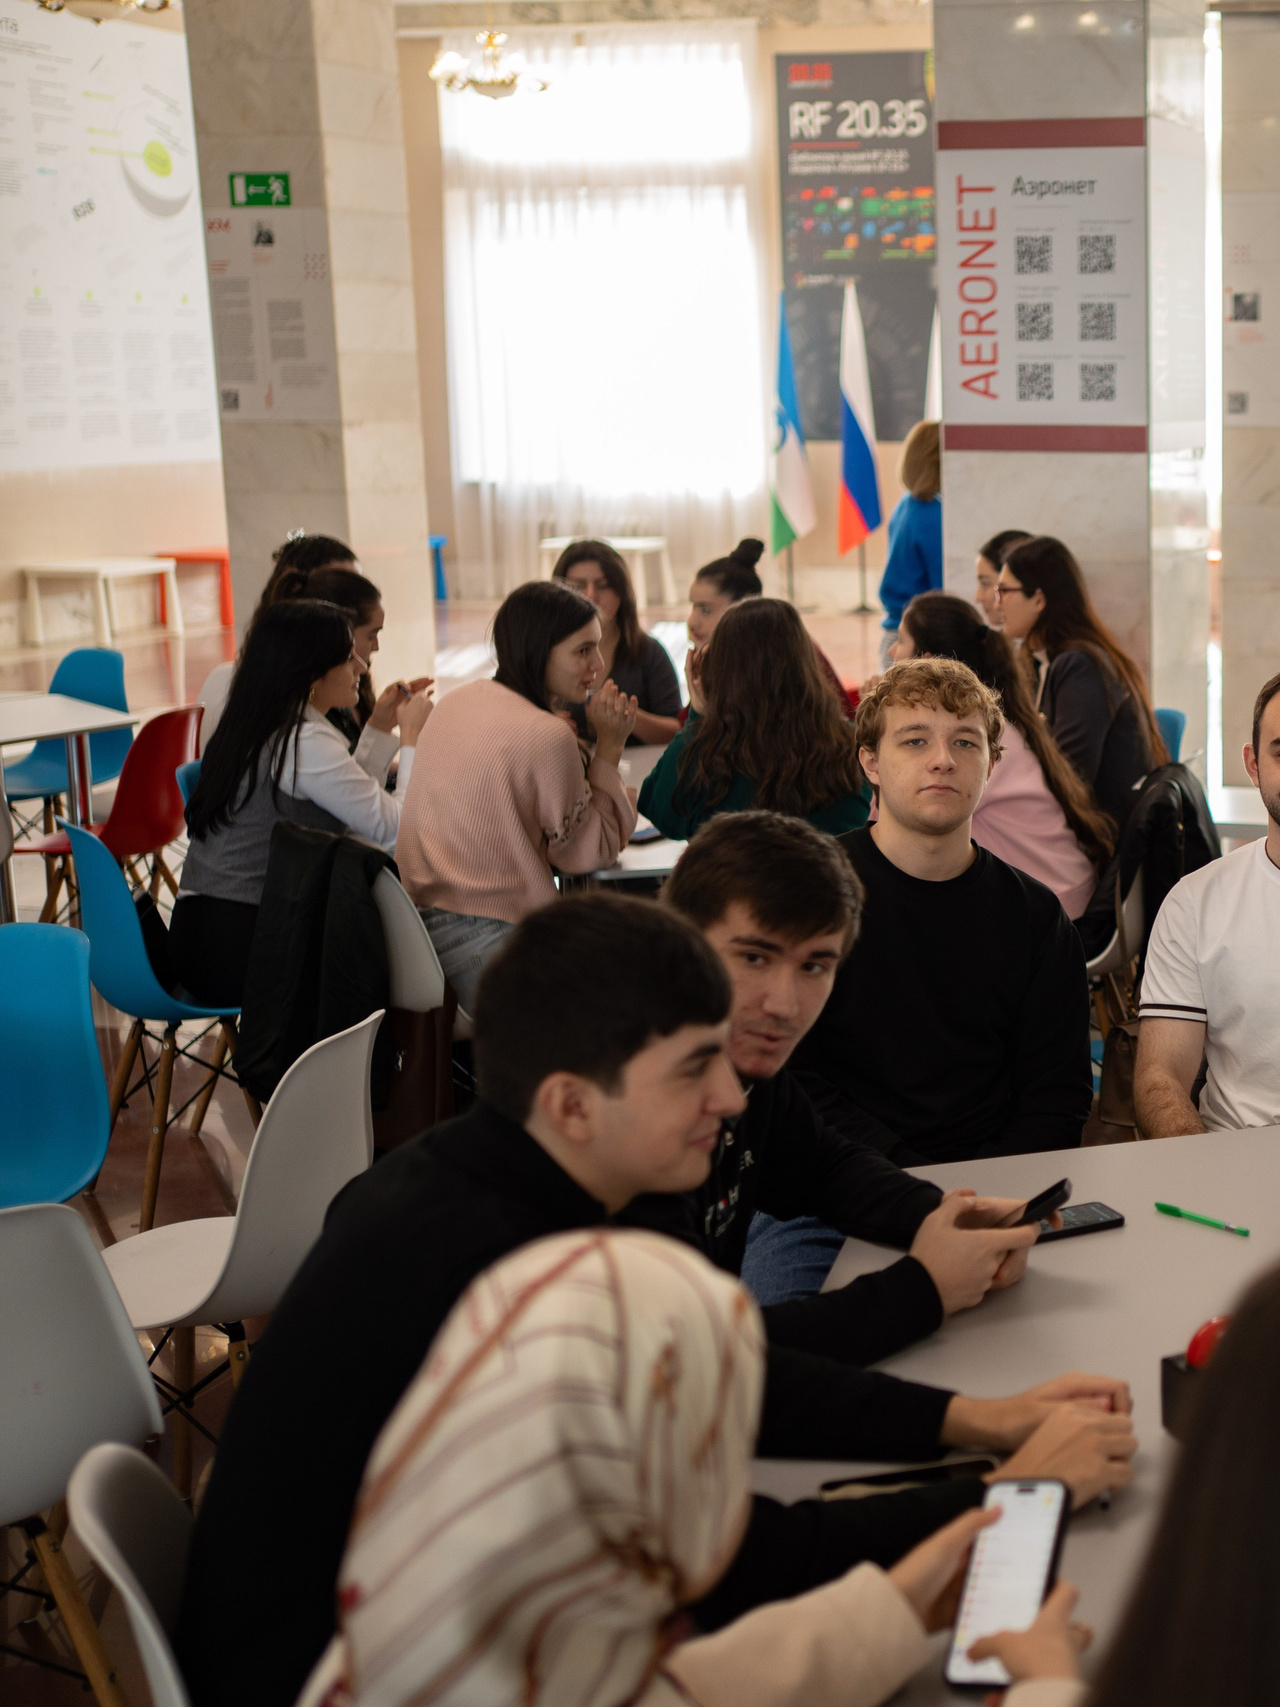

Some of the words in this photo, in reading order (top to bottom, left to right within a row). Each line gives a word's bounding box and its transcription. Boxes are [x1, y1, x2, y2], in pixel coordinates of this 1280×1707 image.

[789, 99, 833, 139] RF
[836, 98, 927, 138] 20.35
[1011, 176, 1098, 199] Аэронет
[956, 174, 1000, 400] AERONET
